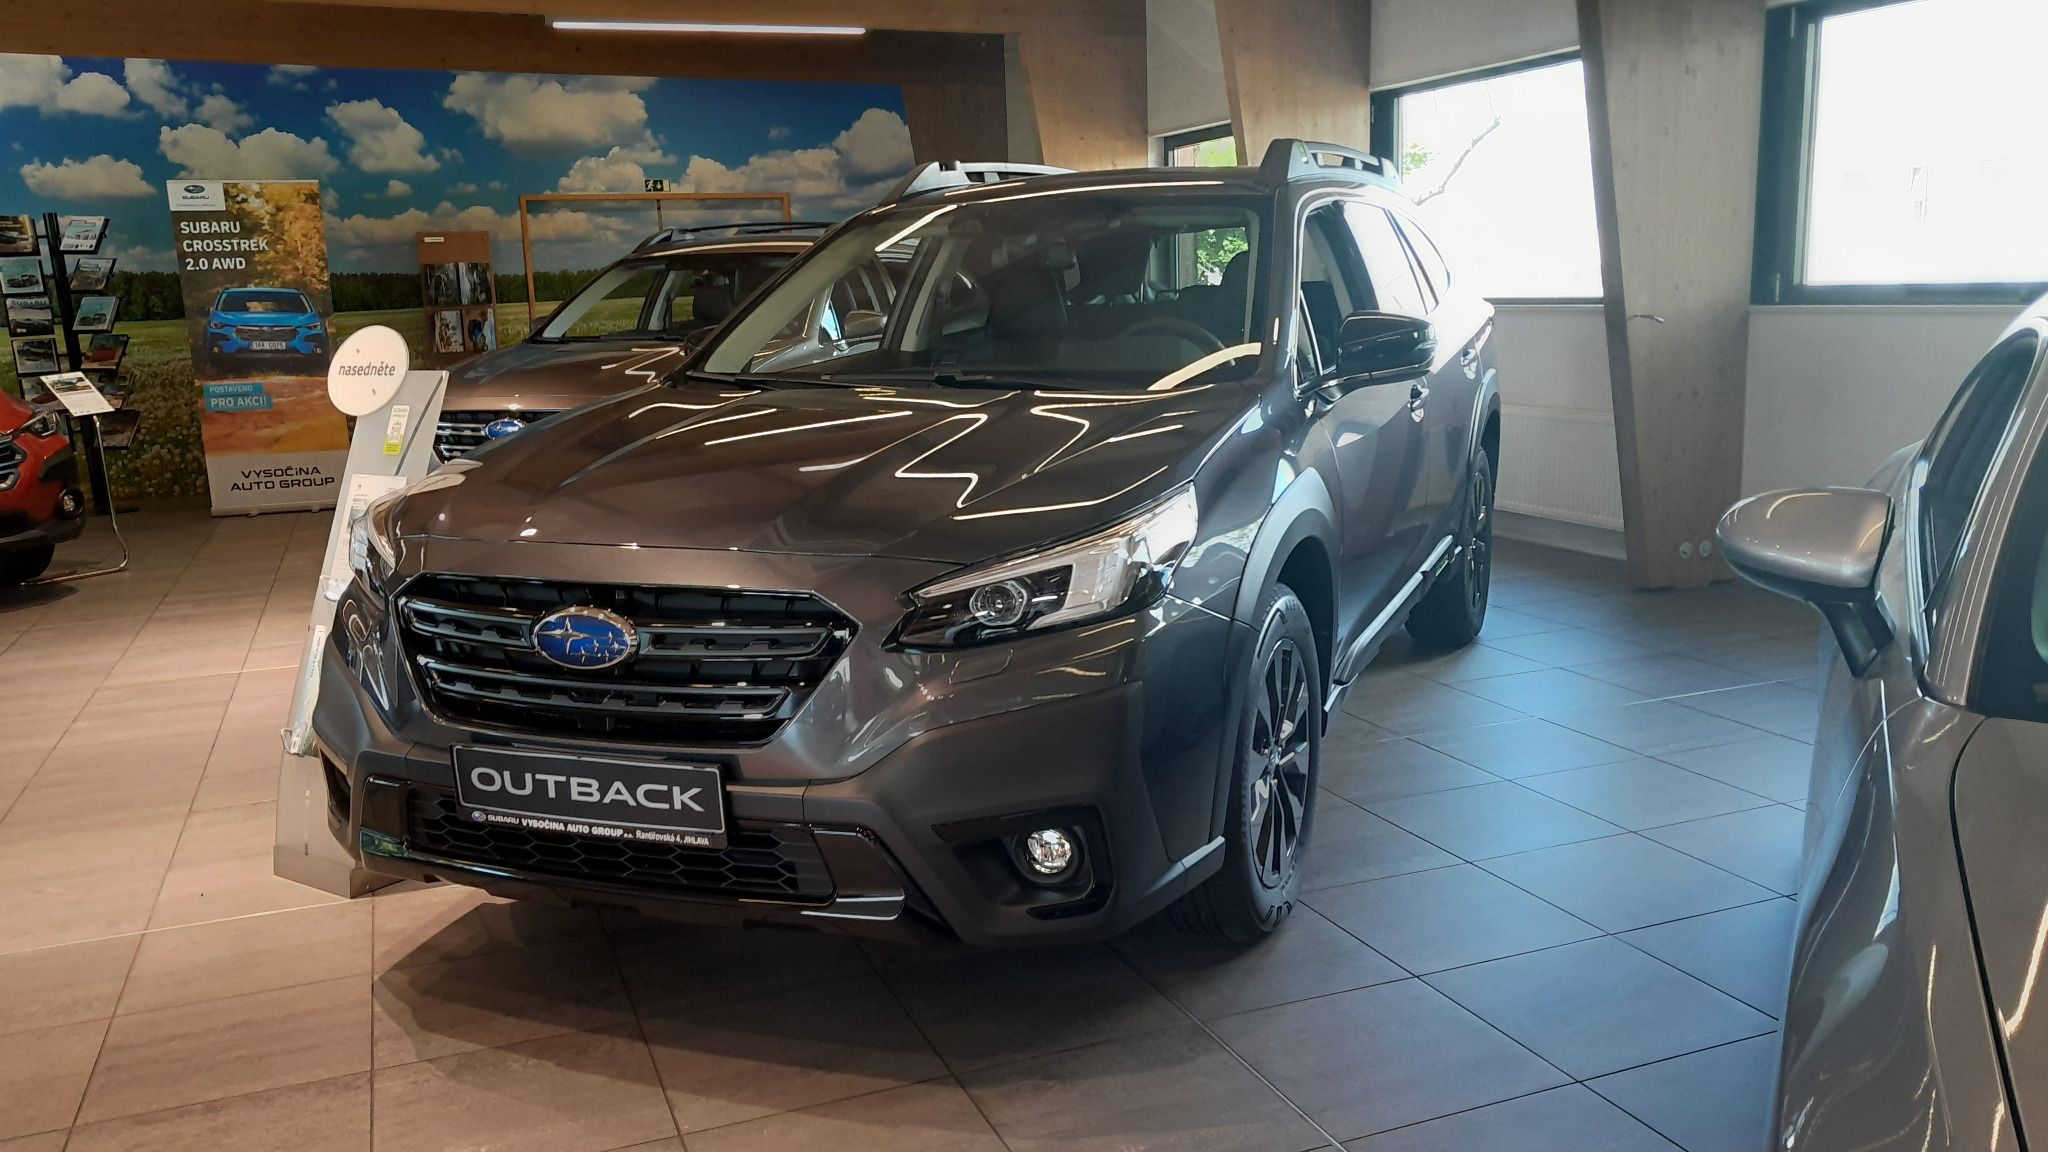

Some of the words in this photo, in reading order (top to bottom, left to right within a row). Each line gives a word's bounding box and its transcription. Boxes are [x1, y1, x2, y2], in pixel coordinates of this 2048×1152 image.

[180, 221, 241, 234] SUBARU
[183, 239, 269, 252] CROSSTREK
[185, 258, 209, 271] 2.0
[212, 257, 246, 270] AWD
[338, 361, 396, 376] nasedněte
[209, 385, 254, 393] POSTAVENO
[211, 397, 234, 408] PRO
[230, 481, 275, 492] AUTO
[280, 477, 335, 488] GROUP
[470, 767, 706, 812] OUTBACK
[487, 814, 519, 824] SUBARU
[521, 818, 565, 831] VYSOČINA
[566, 823, 590, 834] AUTO
[591, 826, 624, 837] GROUP
[675, 834, 683, 844] 4,
[683, 835, 710, 846] JIHLAVA
